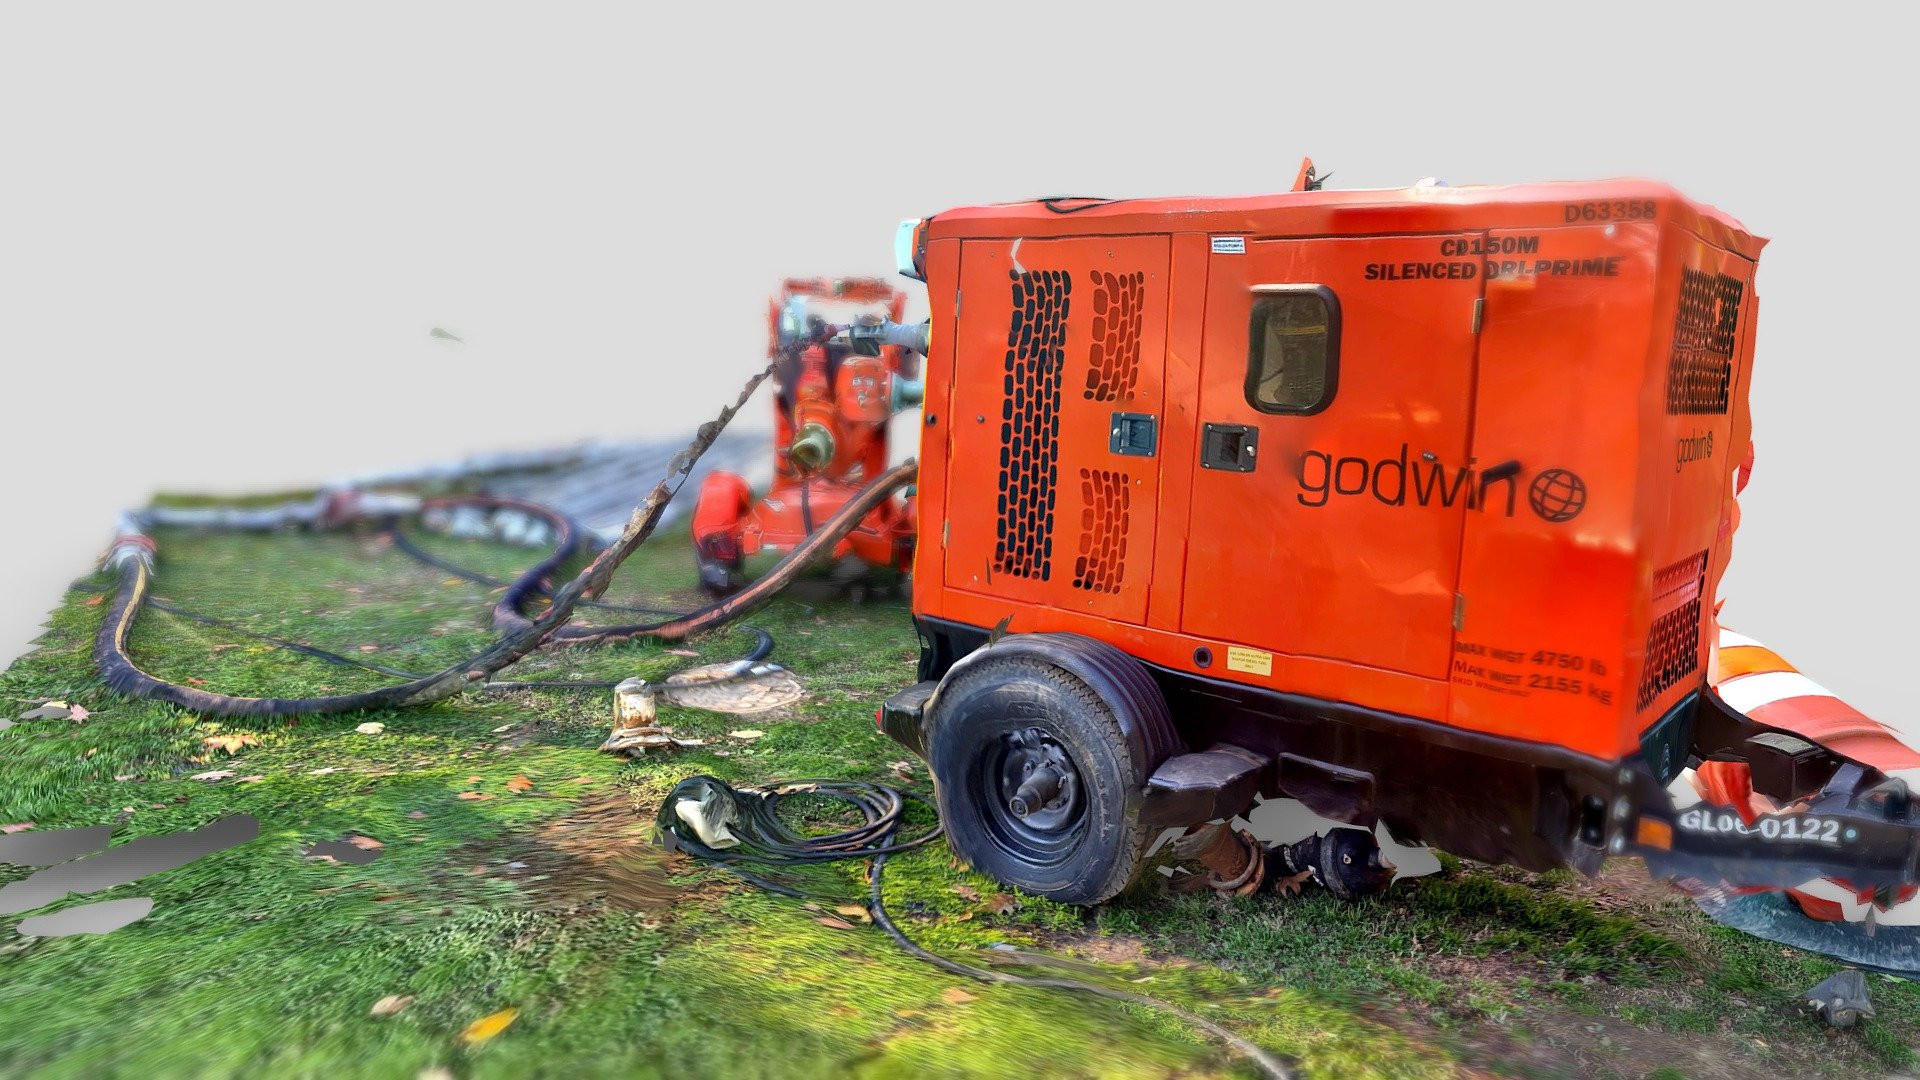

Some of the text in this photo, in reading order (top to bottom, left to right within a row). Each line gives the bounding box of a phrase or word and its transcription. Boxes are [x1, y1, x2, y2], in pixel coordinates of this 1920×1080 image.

[1565, 201, 1657, 223] D63358
[1364, 256, 1621, 281] SILENCED DRI-PRIME
[1297, 443, 1517, 518] godwin
[1531, 650, 1584, 671] 4750
[1528, 673, 1583, 695] 2155
